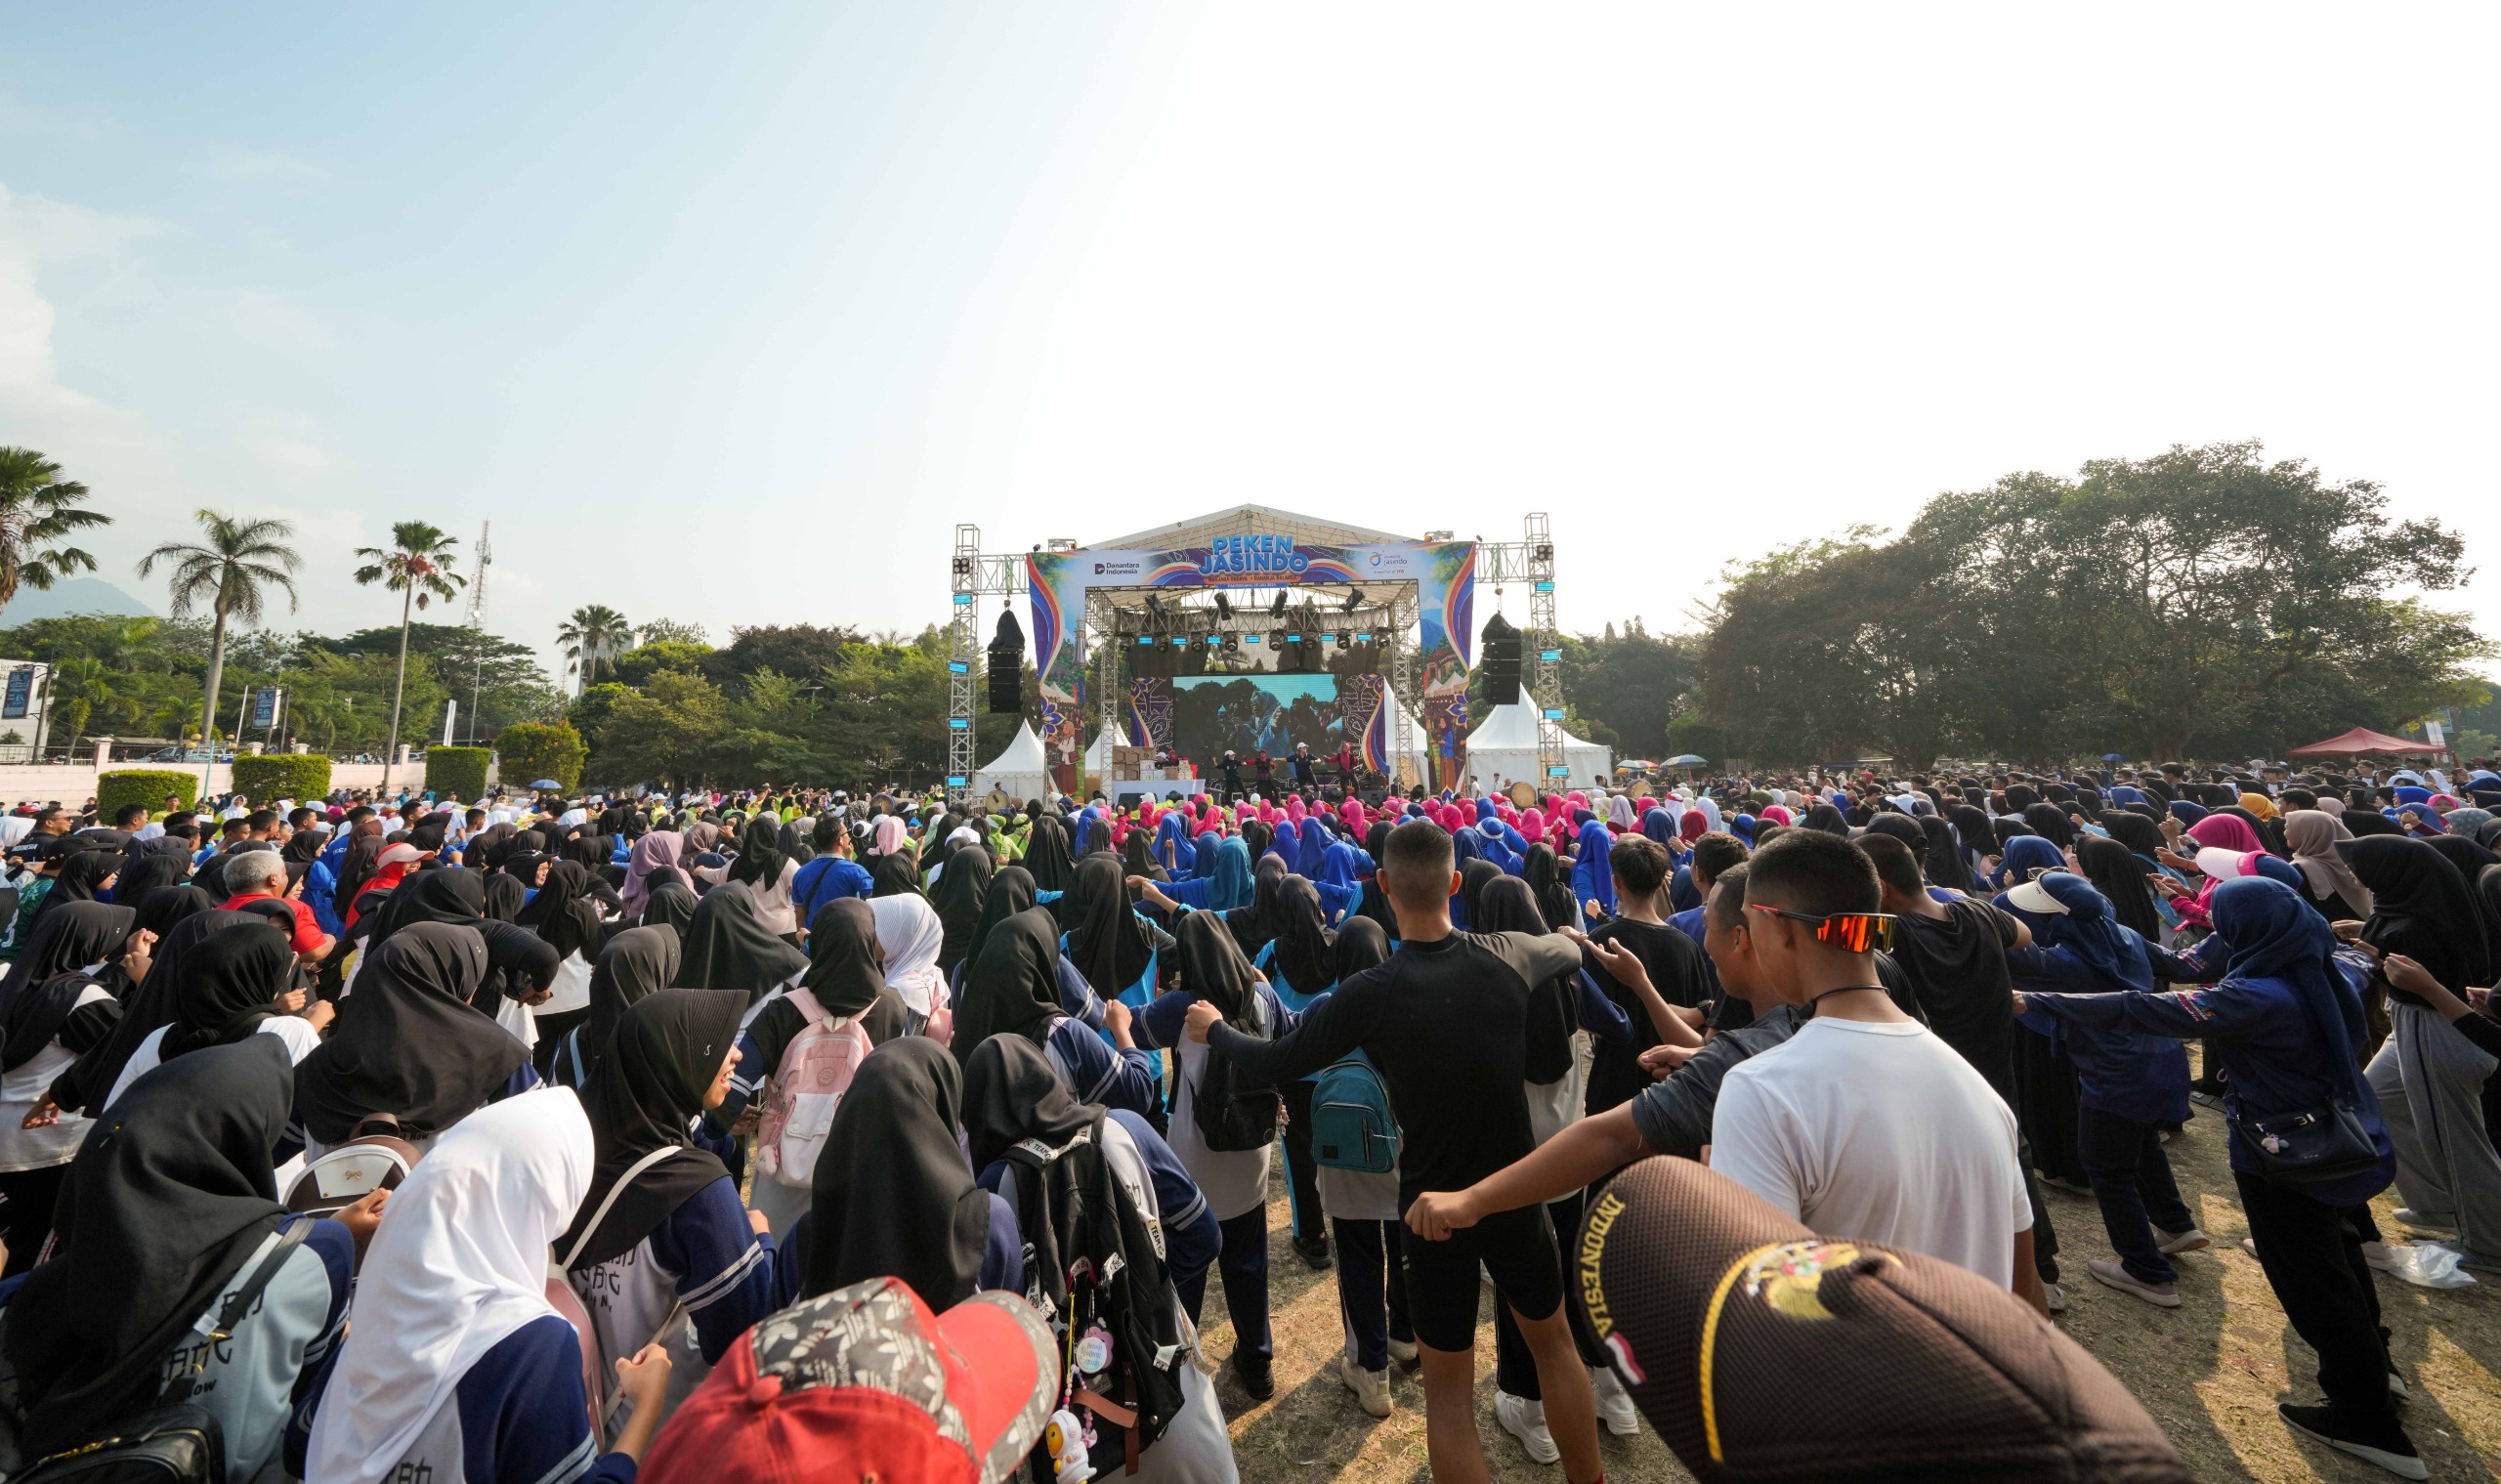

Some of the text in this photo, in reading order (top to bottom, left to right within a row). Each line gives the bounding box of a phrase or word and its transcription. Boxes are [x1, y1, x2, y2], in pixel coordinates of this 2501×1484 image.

[1212, 534, 1293, 555] PEKEN
[1199, 552, 1308, 574] JASINDO
[1033, 1143, 1049, 1156] TEAM
[1151, 1226, 1162, 1247] TEAM
[1580, 1193, 1626, 1339] INDONESIA
